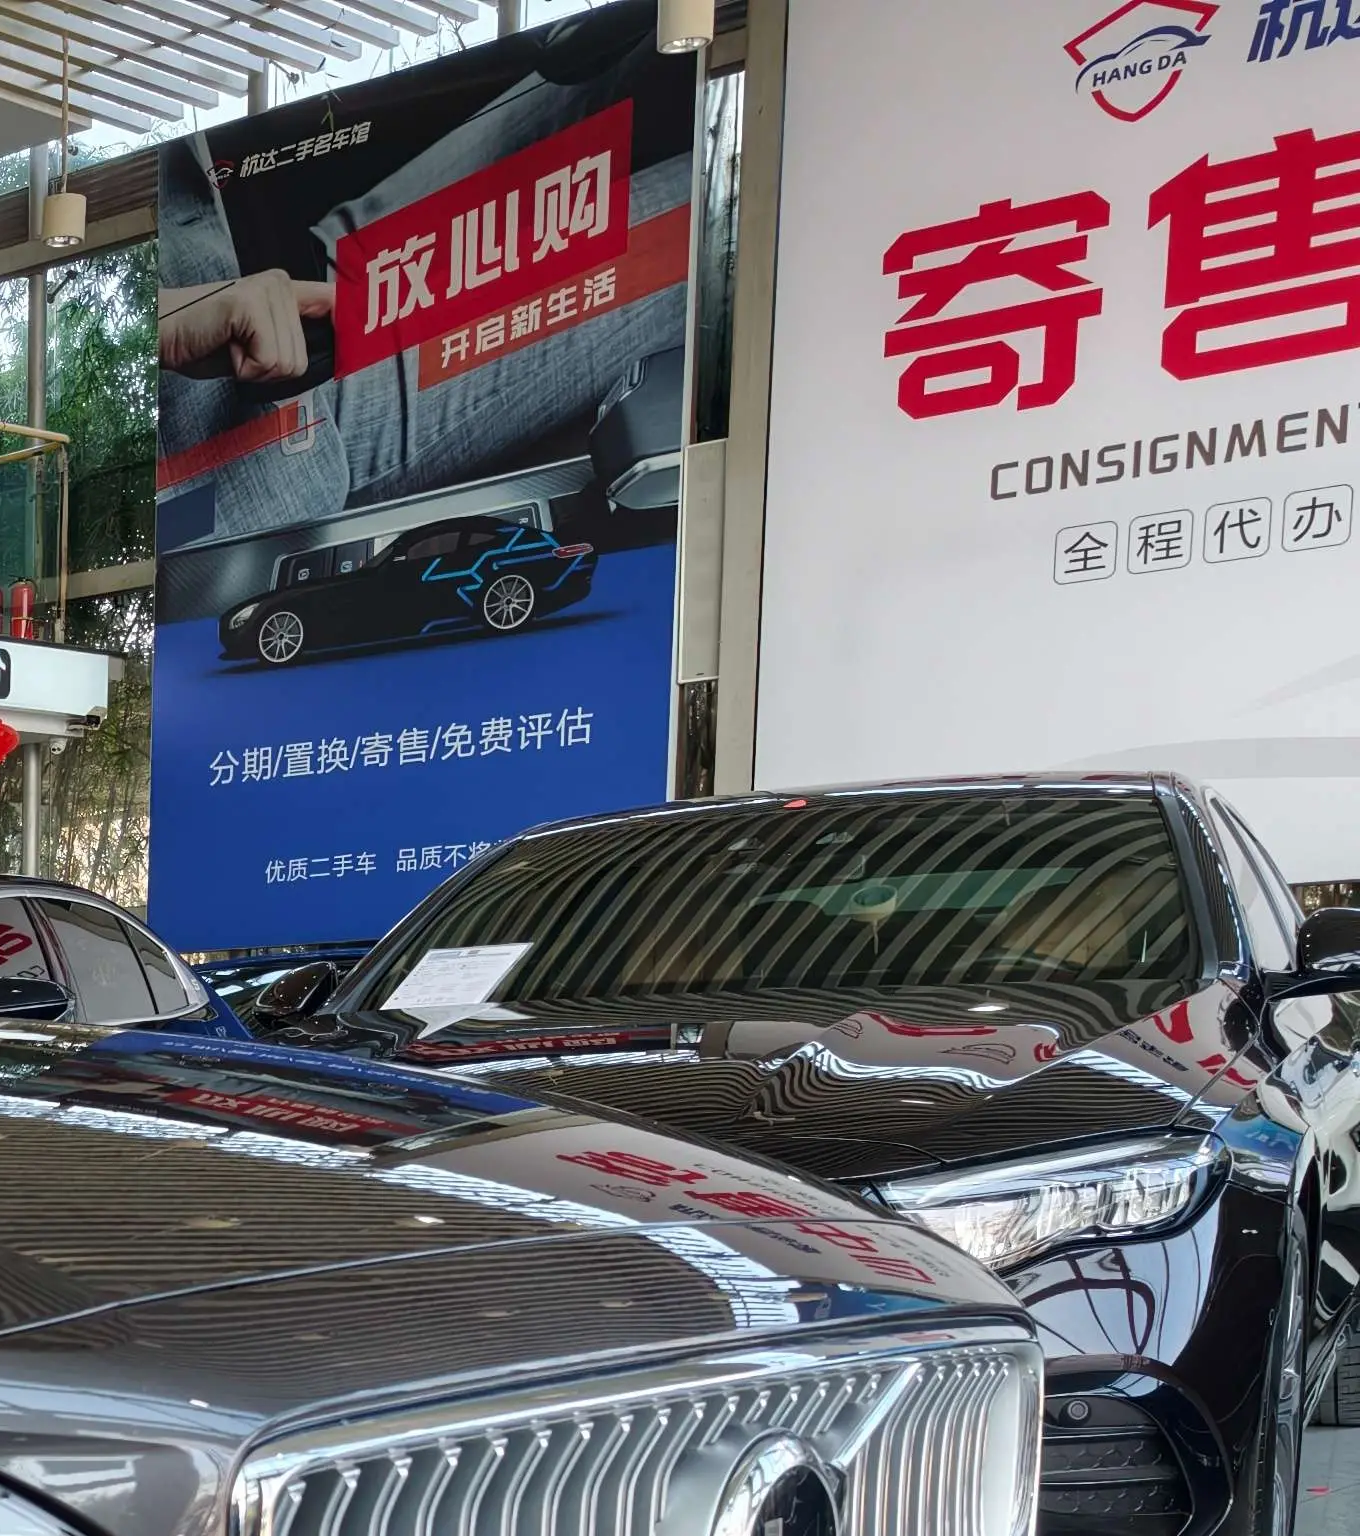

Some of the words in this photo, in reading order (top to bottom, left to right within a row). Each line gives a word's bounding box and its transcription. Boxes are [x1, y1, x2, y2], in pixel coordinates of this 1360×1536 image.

[1092, 59, 1153, 87] HANG
[1157, 51, 1187, 71] DA
[1246, 0, 1360, 62] 杭
[240, 121, 371, 177] 杭达二手名车馆
[364, 150, 612, 335] 放心购
[883, 128, 1360, 420] 寄售
[440, 267, 617, 368] 开启新生活
[990, 402, 1360, 500] CONSIGNMEN
[1063, 496, 1343, 575] 全程代办
[209, 706, 594, 786] 分期/置换/寄售/免费评估
[265, 851, 377, 884] 优质二手车
[396, 839, 508, 872] 品质不将
